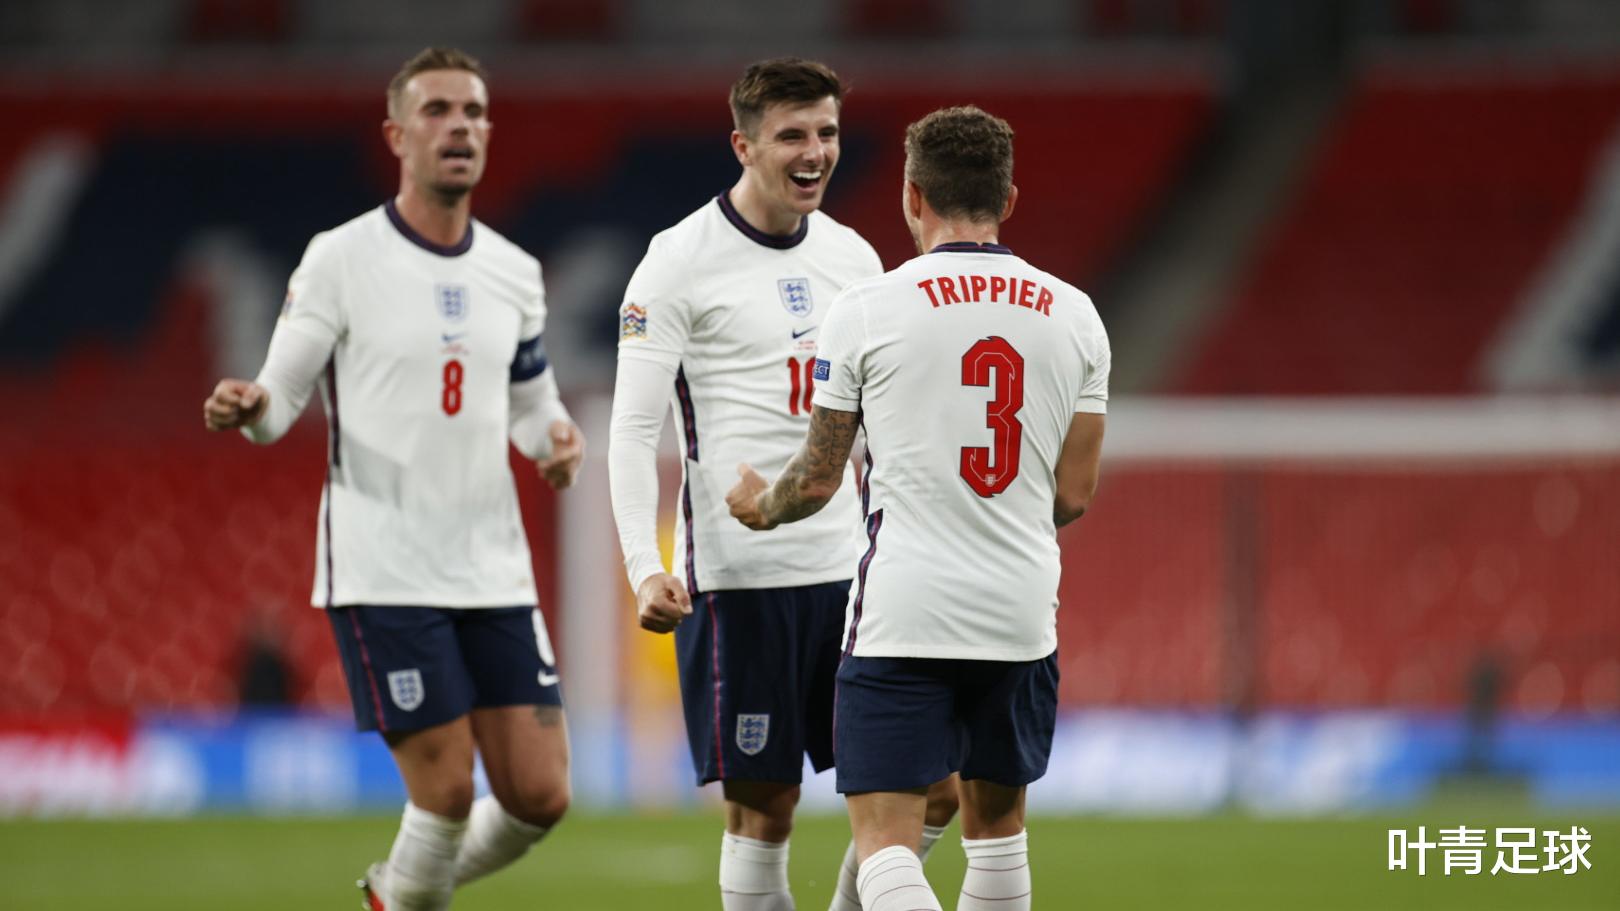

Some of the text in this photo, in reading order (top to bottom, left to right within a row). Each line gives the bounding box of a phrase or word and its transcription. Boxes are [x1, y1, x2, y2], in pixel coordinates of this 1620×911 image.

[918, 275, 1054, 317] TRIPPIER
[441, 359, 464, 417] 8
[960, 336, 1025, 498] 3
